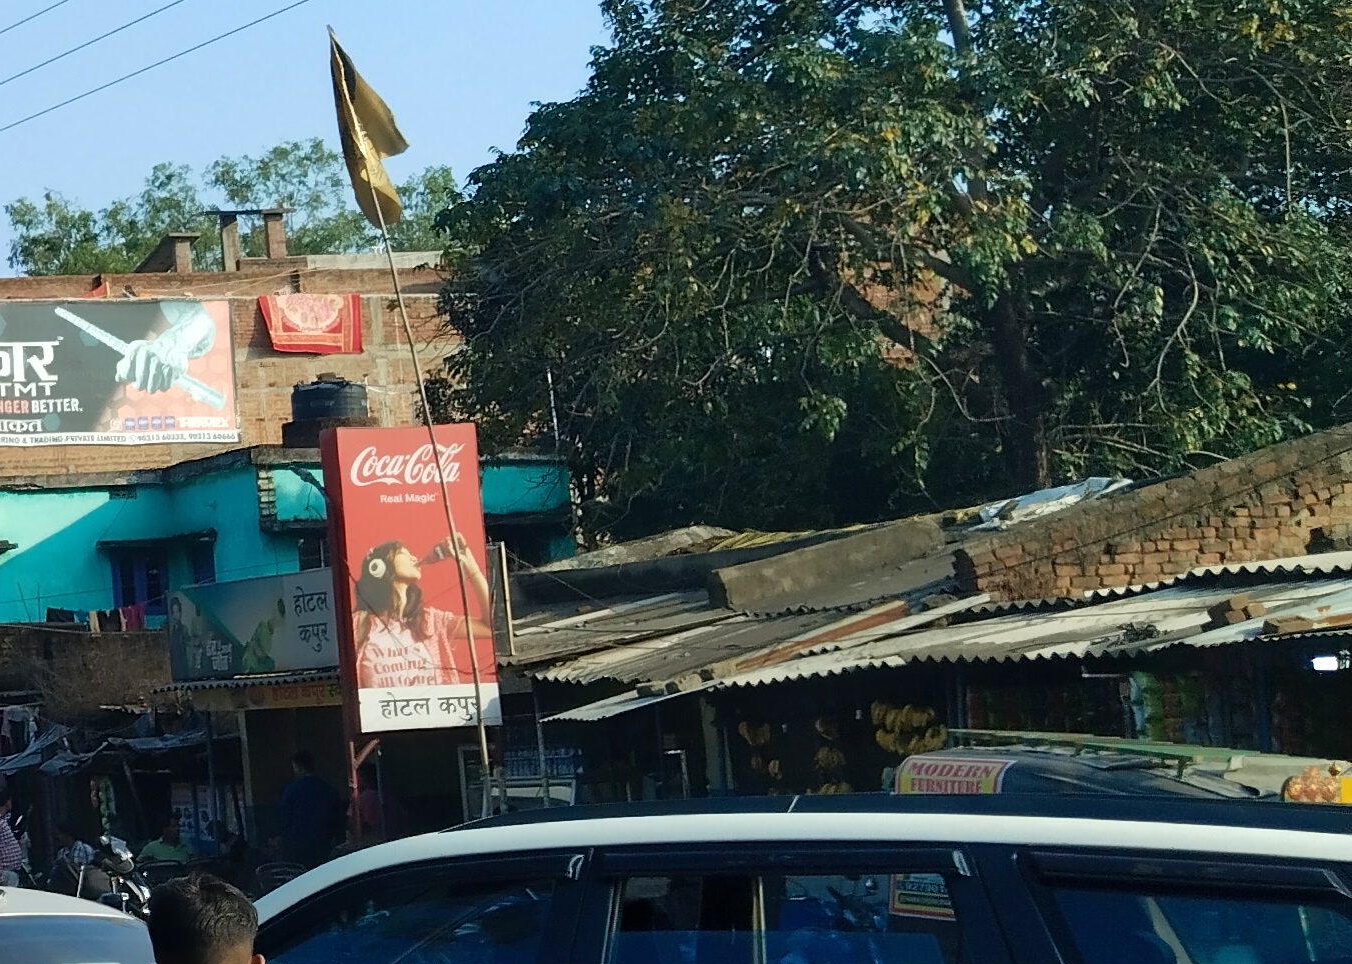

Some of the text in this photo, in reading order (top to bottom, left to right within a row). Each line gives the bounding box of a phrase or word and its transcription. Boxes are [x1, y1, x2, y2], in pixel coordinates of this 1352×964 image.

[350, 443, 465, 486] Coca-Cola
[380, 493, 436, 504] Real Magic
[293, 586, 329, 617] होटल
[379, 692, 431, 719] होटल
[910, 762, 996, 778] MODERN
